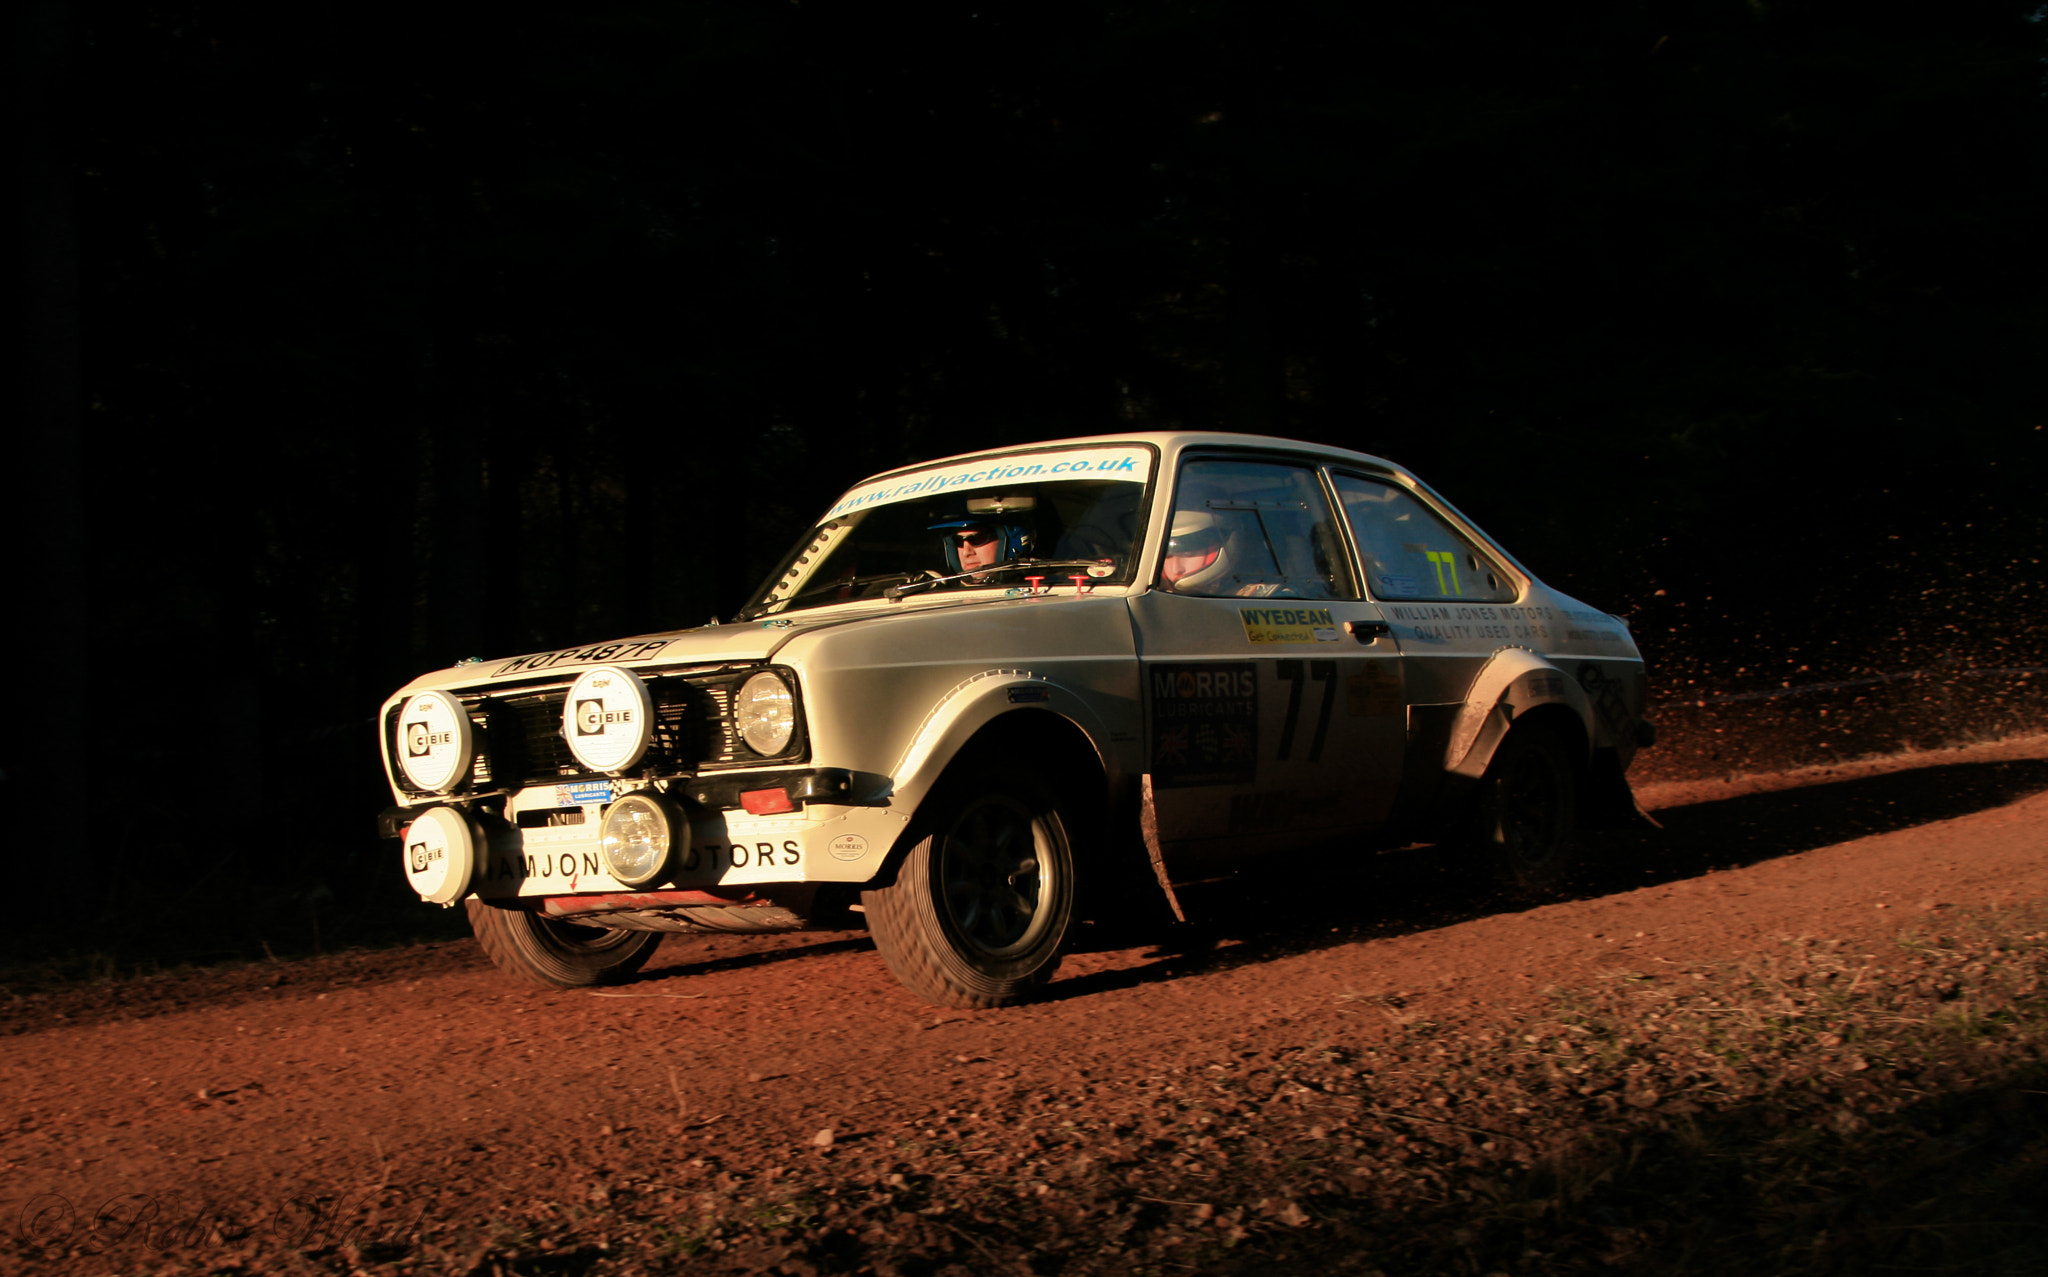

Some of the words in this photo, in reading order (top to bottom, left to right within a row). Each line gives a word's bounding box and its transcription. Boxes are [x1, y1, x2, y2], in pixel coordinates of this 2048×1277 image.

[829, 456, 1139, 516] www.rallyaction.co.uk
[1425, 551, 1462, 596] 77
[1241, 609, 1335, 626] WYEDEAN
[1391, 606, 1450, 621] WILLIAM
[1455, 606, 1498, 621] JONES
[1501, 606, 1553, 621] MOTORS
[1414, 625, 1472, 640] QUALITY
[1476, 625, 1511, 640] USED
[1513, 625, 1549, 640] CARS
[500, 640, 668, 673] MOP487P
[1153, 670, 1255, 699] MORRIS
[588, 711, 631, 724] CIBIE
[1157, 701, 1255, 718] LUBRICANTS
[1276, 659, 1337, 763] 77
[416, 732, 451, 746] CIBIE
[570, 782, 610, 794] MORRIS
[417, 848, 444, 865] CIBIE
